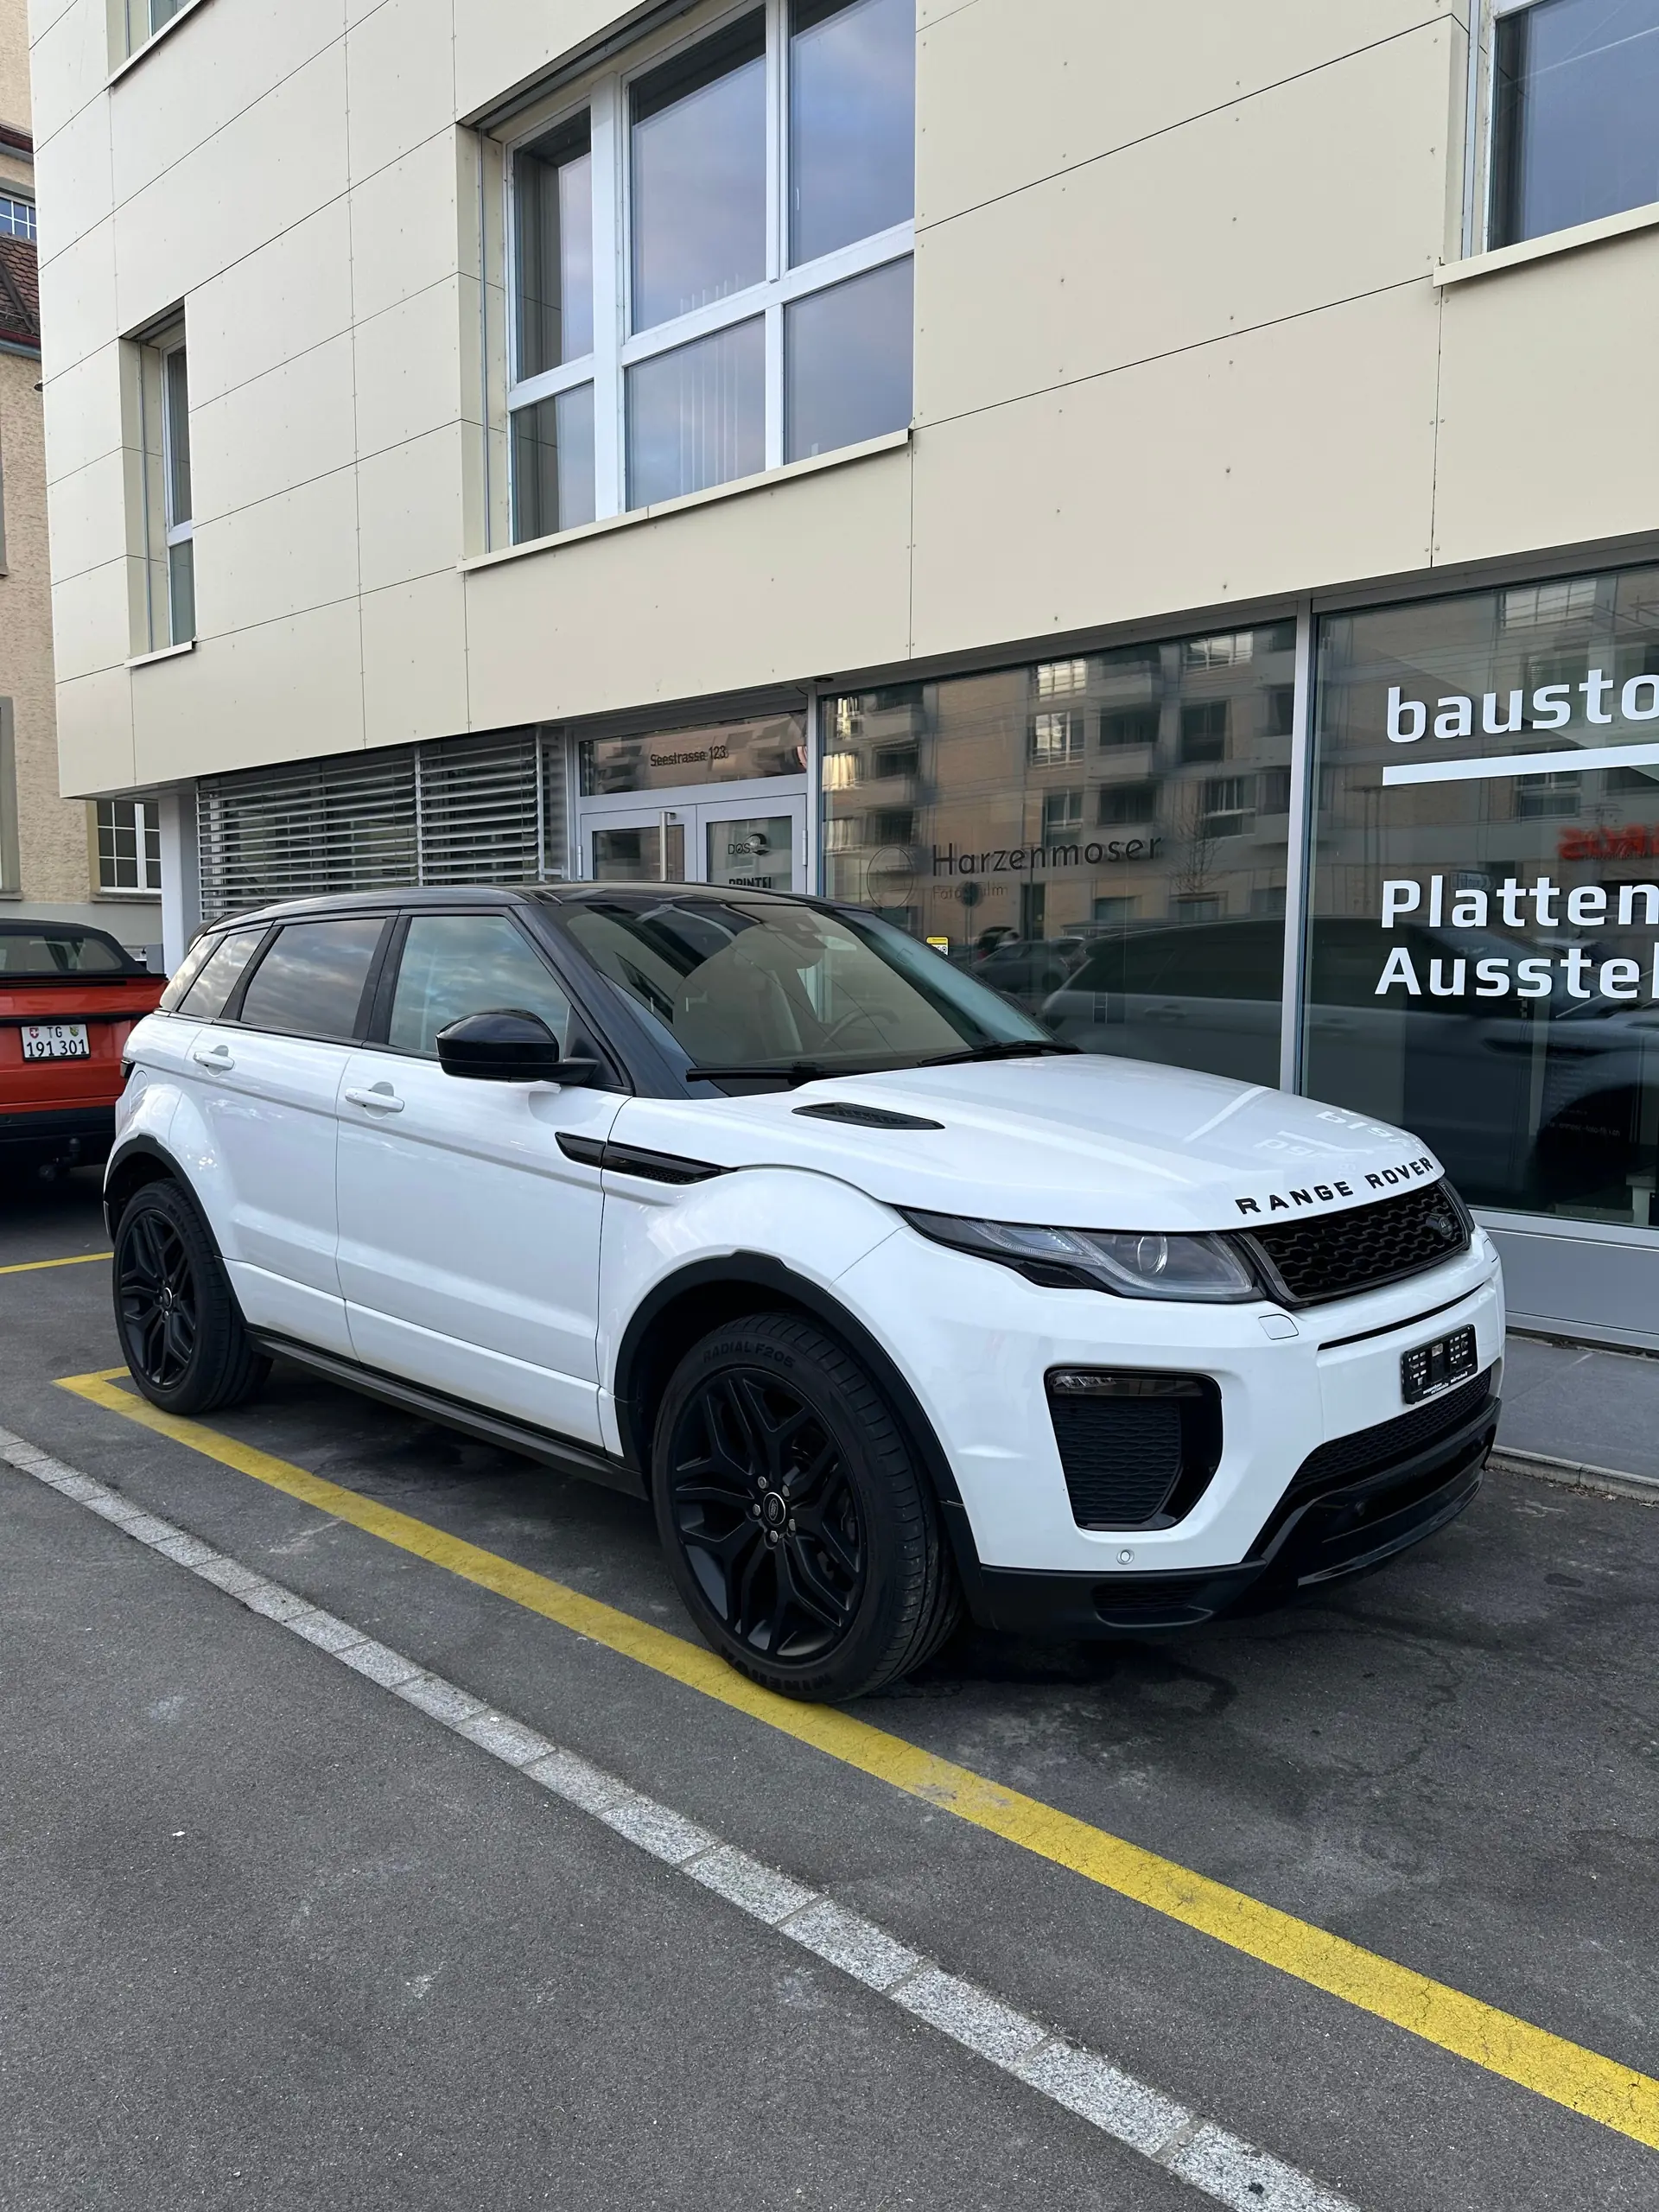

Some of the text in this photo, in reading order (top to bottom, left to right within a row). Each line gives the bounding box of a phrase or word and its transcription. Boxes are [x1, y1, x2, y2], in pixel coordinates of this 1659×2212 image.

[1386, 669, 1659, 743] bausto
[651, 745, 727, 767] Seestrasse 123
[933, 836, 1162, 877] Harzenmoser
[1382, 874, 1659, 929] Platten
[27, 1039, 86, 1058] 191 301
[47, 1026, 63, 1039] TG
[1235, 1156, 1434, 1215] RANGE ROVER
[703, 1339, 796, 1369] RADIAL F205
